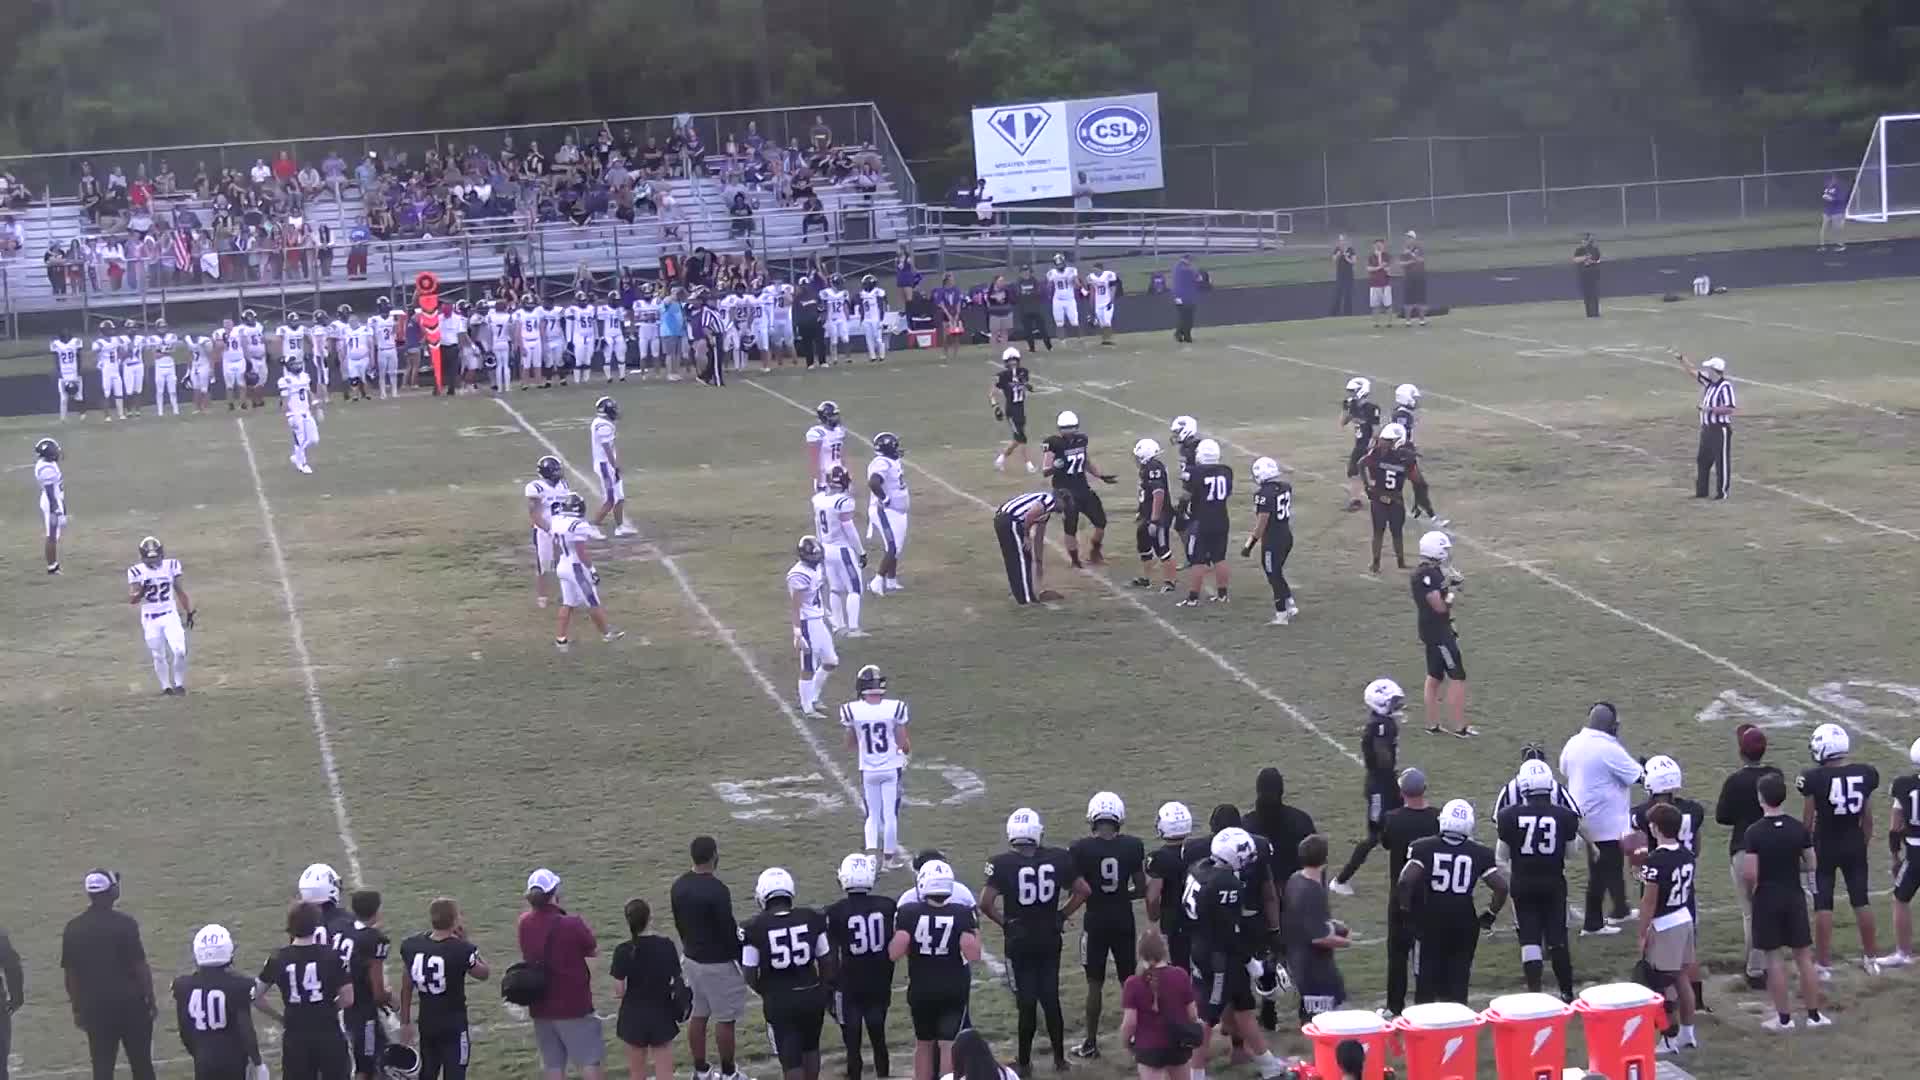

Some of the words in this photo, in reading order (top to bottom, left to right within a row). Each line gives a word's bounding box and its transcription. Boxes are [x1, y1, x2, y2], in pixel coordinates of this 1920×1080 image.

[1095, 123, 1133, 140] CSL
[496, 324, 504, 337] 7
[1066, 453, 1086, 475] 77
[1385, 470, 1397, 489] 5
[1204, 475, 1228, 501] 70
[820, 510, 829, 534] 9
[144, 582, 170, 604] 22
[859, 721, 889, 755] 13
[1828, 775, 1864, 816] 45
[1517, 815, 1558, 855] 73
[1018, 863, 1057, 907] 66
[1101, 857, 1119, 893] 9
[1431, 852, 1473, 895] 50
[1640, 864, 1658, 880] 22
[1666, 862, 1695, 907] 22
[1218, 890, 1239, 905] 75
[767, 923, 812, 970] 55
[848, 911, 885, 956] 30
[914, 914, 955, 957] 47
[285, 961, 324, 1004] 14
[411, 952, 447, 996] 43
[187, 988, 228, 1031] 40
